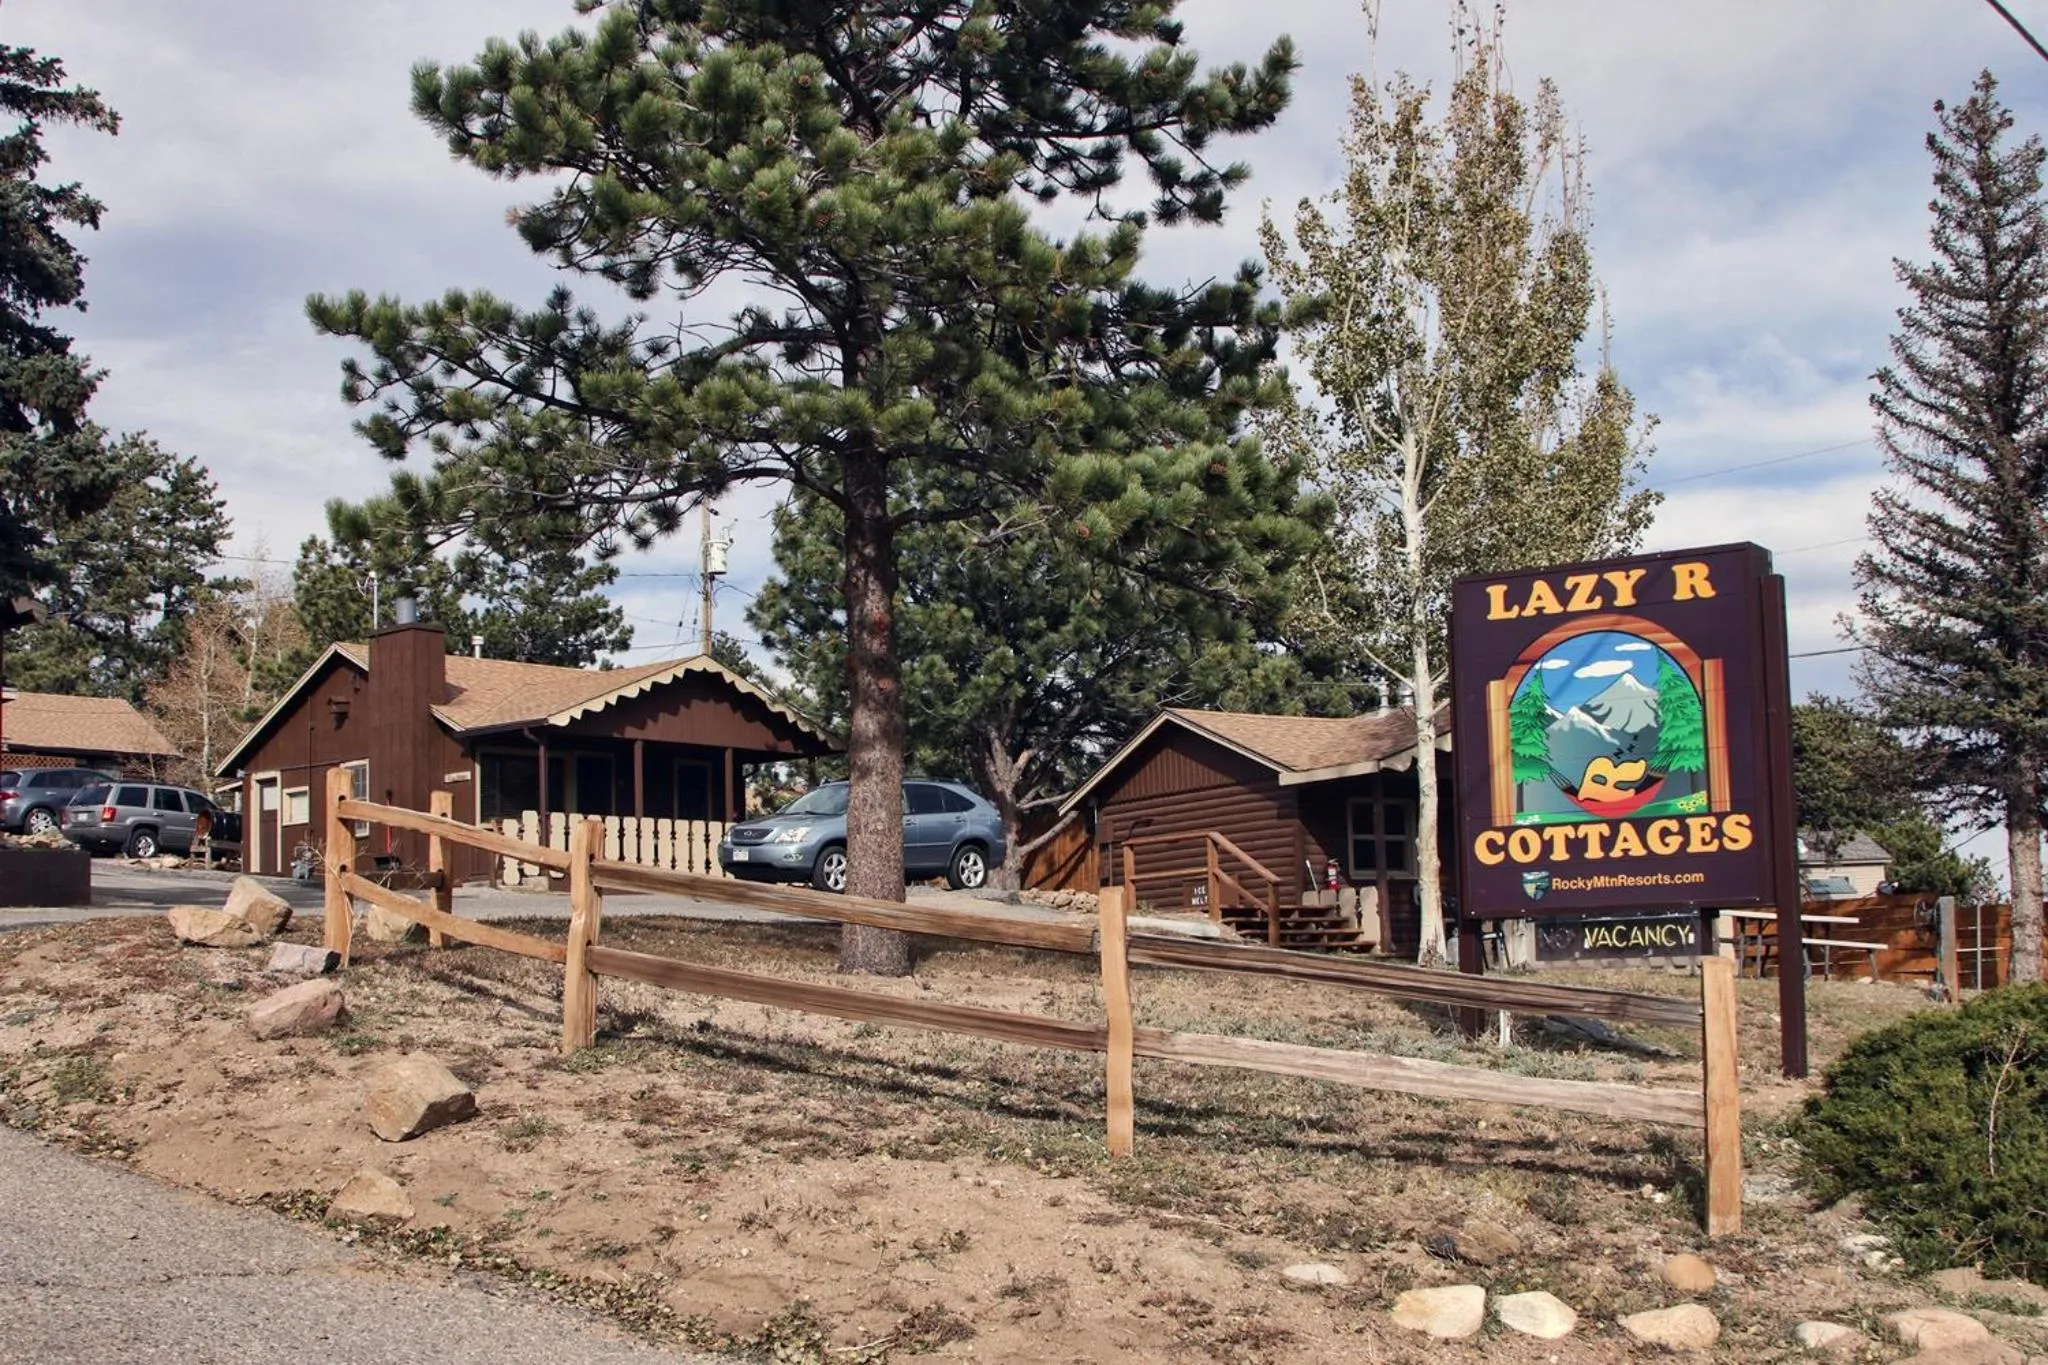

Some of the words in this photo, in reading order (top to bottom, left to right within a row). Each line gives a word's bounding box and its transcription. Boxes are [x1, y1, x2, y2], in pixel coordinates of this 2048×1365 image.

[1486, 568, 1646, 621] LAZY
[1672, 561, 1716, 601] R
[1474, 814, 1753, 866] COTTAGES
[1551, 872, 1705, 891] RockyMtnResorts.com
[1584, 924, 1690, 948] VACANCY
